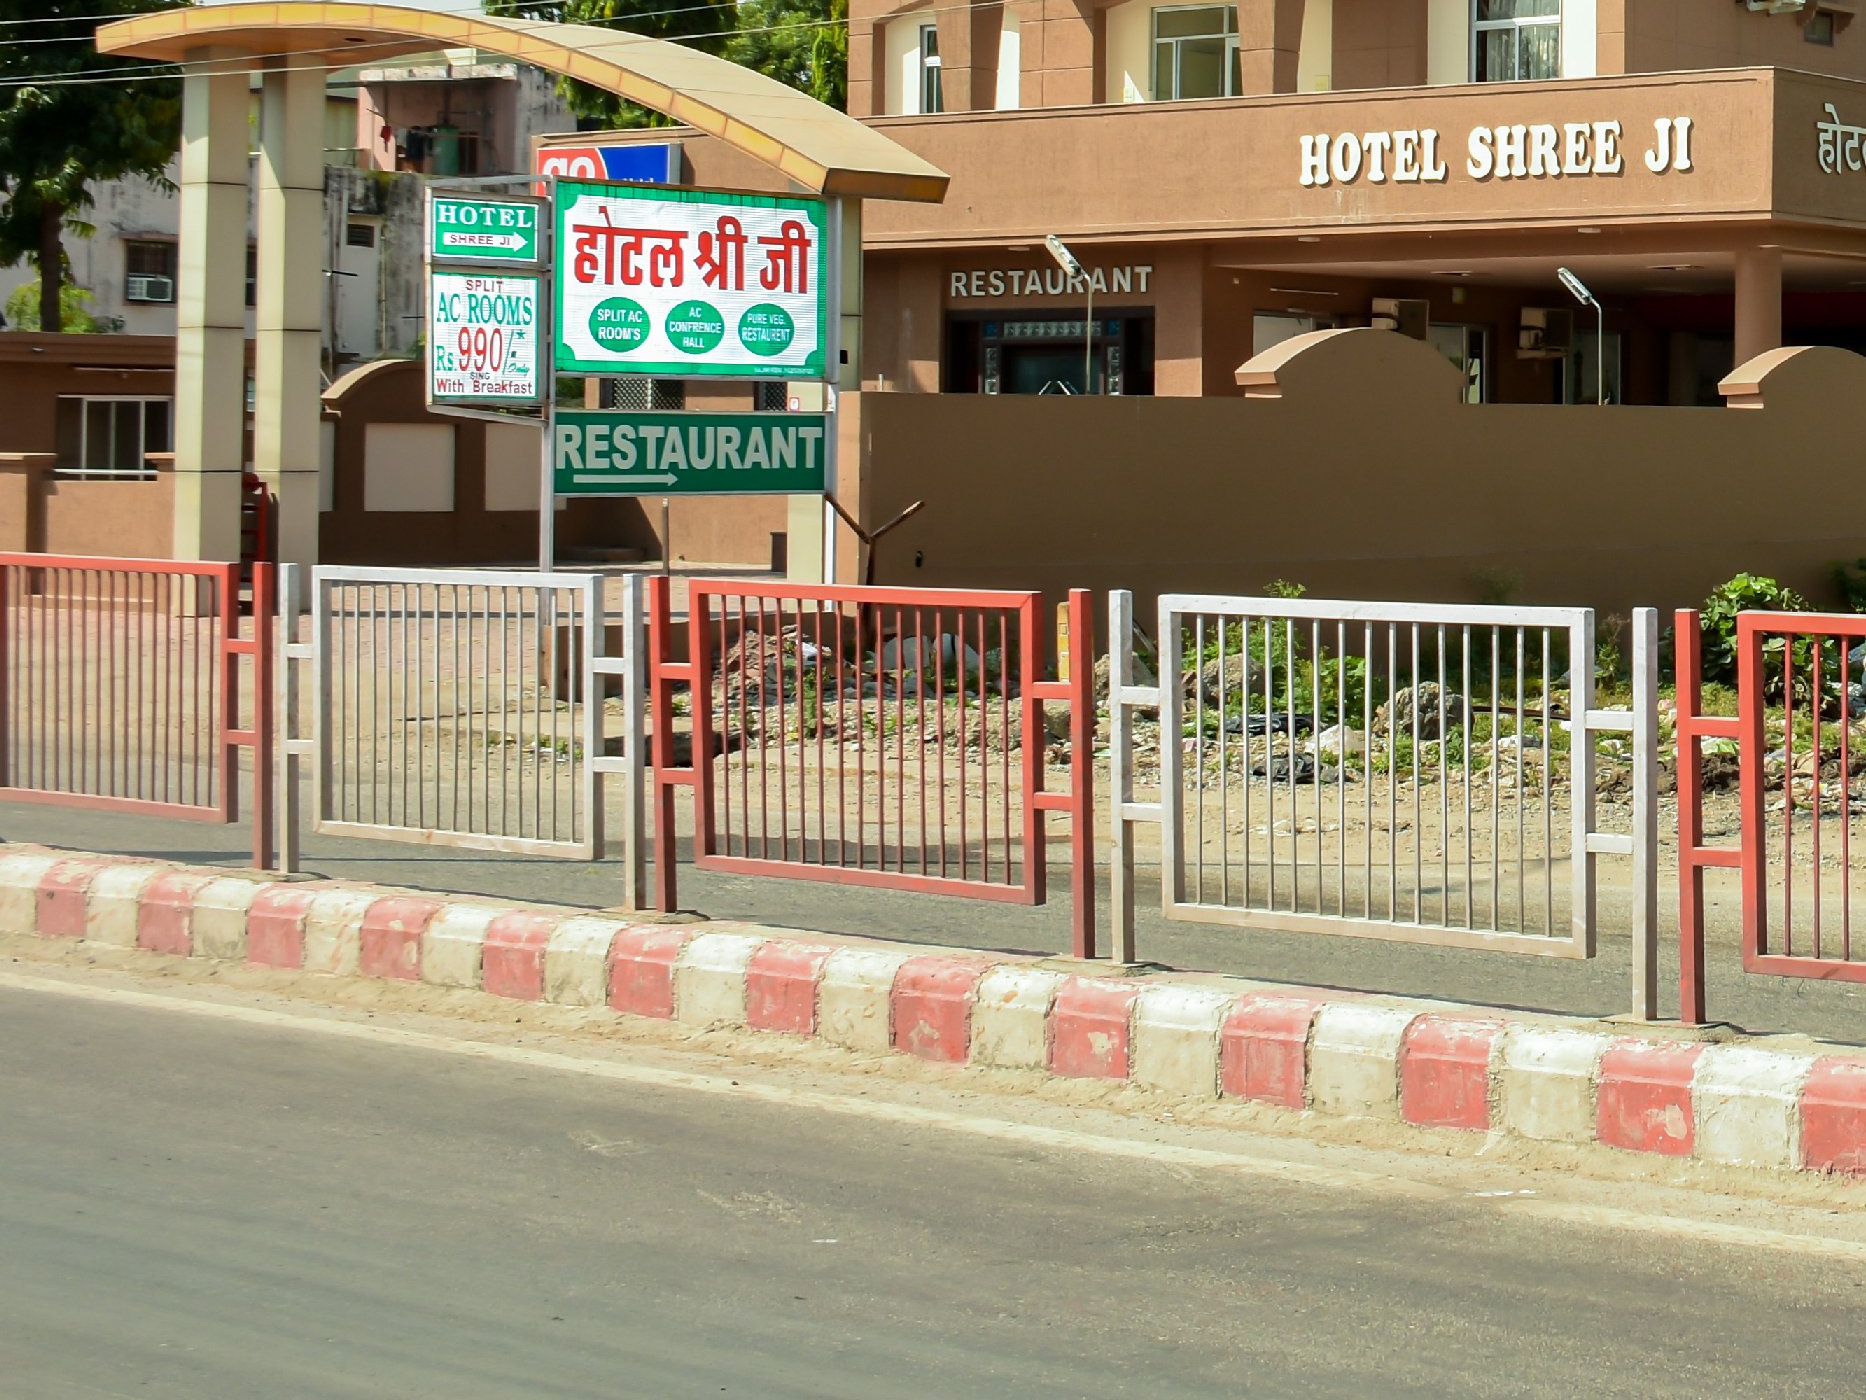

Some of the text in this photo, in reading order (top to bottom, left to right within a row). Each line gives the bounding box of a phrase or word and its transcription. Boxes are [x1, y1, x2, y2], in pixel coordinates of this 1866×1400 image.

[1299, 116, 1693, 186] HOTEL SHREE JI
[437, 204, 533, 229] HOTEL
[450, 234, 511, 246] SHREE JI
[572, 206, 812, 294] होटल श्री जी
[466, 279, 504, 293] SPLIT
[951, 266, 1152, 297] RESTAURANT
[436, 292, 533, 326] AC ROOMS
[597, 308, 643, 323] SPLIT AC
[689, 307, 702, 318] AC
[747, 313, 768, 324] PURE
[598, 326, 641, 340] ROOM'S
[682, 337, 705, 348] HALL
[436, 378, 533, 395] With Breakfast
[555, 424, 823, 470] RESTAURANT
